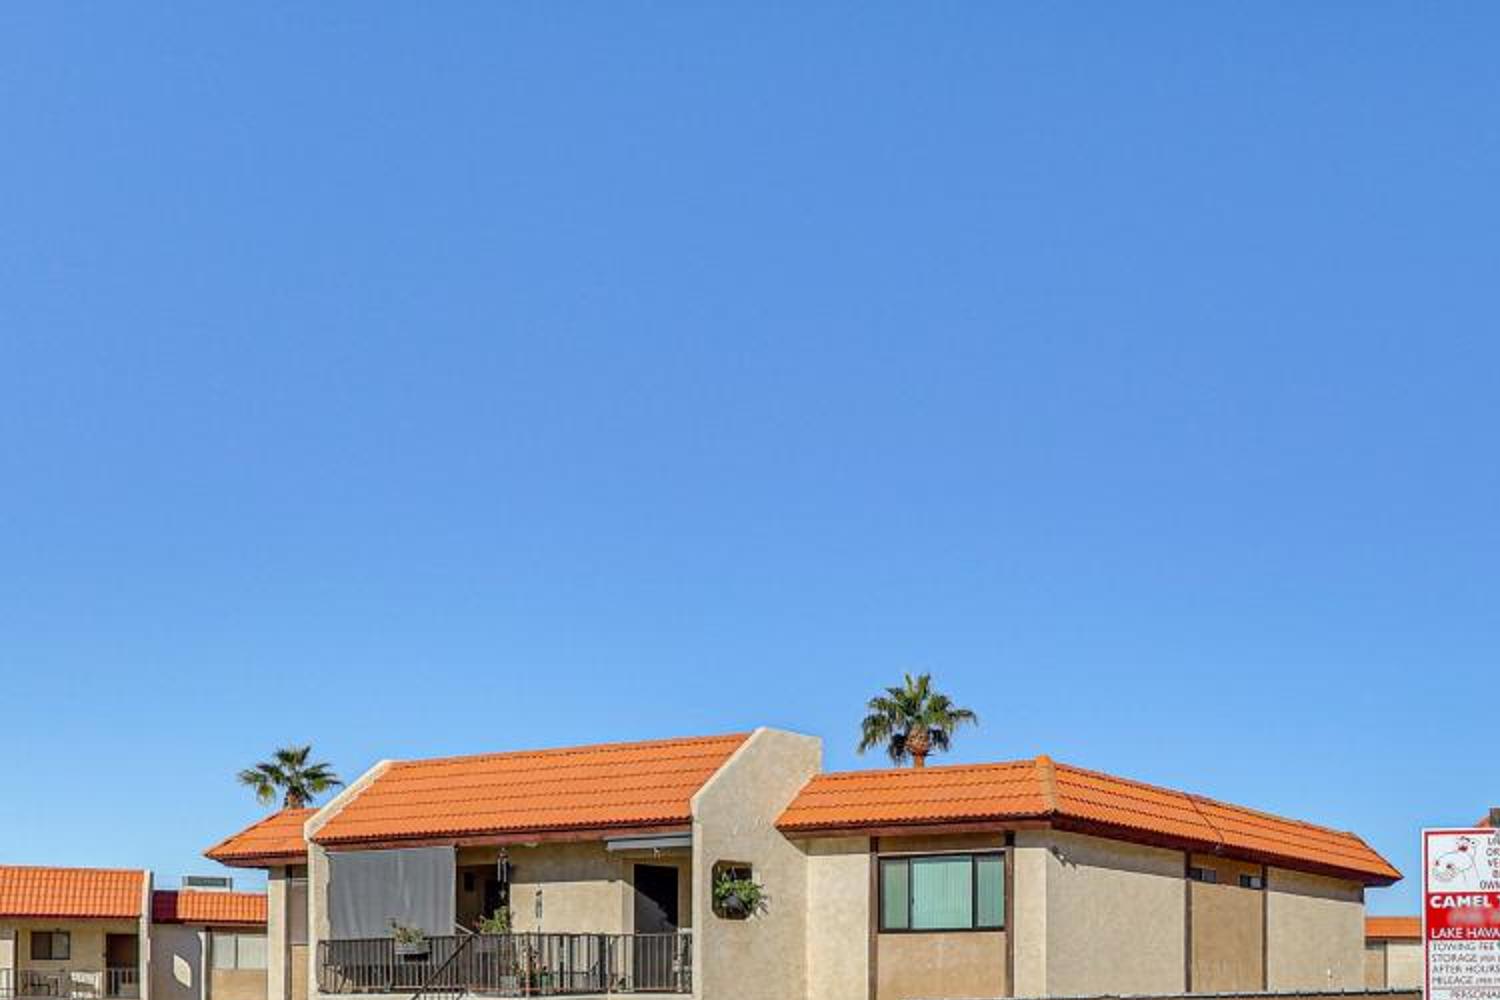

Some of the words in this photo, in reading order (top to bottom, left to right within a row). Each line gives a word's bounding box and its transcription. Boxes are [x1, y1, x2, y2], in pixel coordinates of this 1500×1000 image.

[1430, 895, 1492, 908] CAMEL
[1431, 927, 1464, 939] LAKE
[1432, 942, 1476, 951] TOWING
[1479, 941, 1494, 951] FEE
[1432, 953, 1477, 962] STORAGE
[1432, 964, 1462, 974] AFTER
[1465, 964, 1500, 974] HOURS
[1432, 975, 1474, 984] MILEAGE
